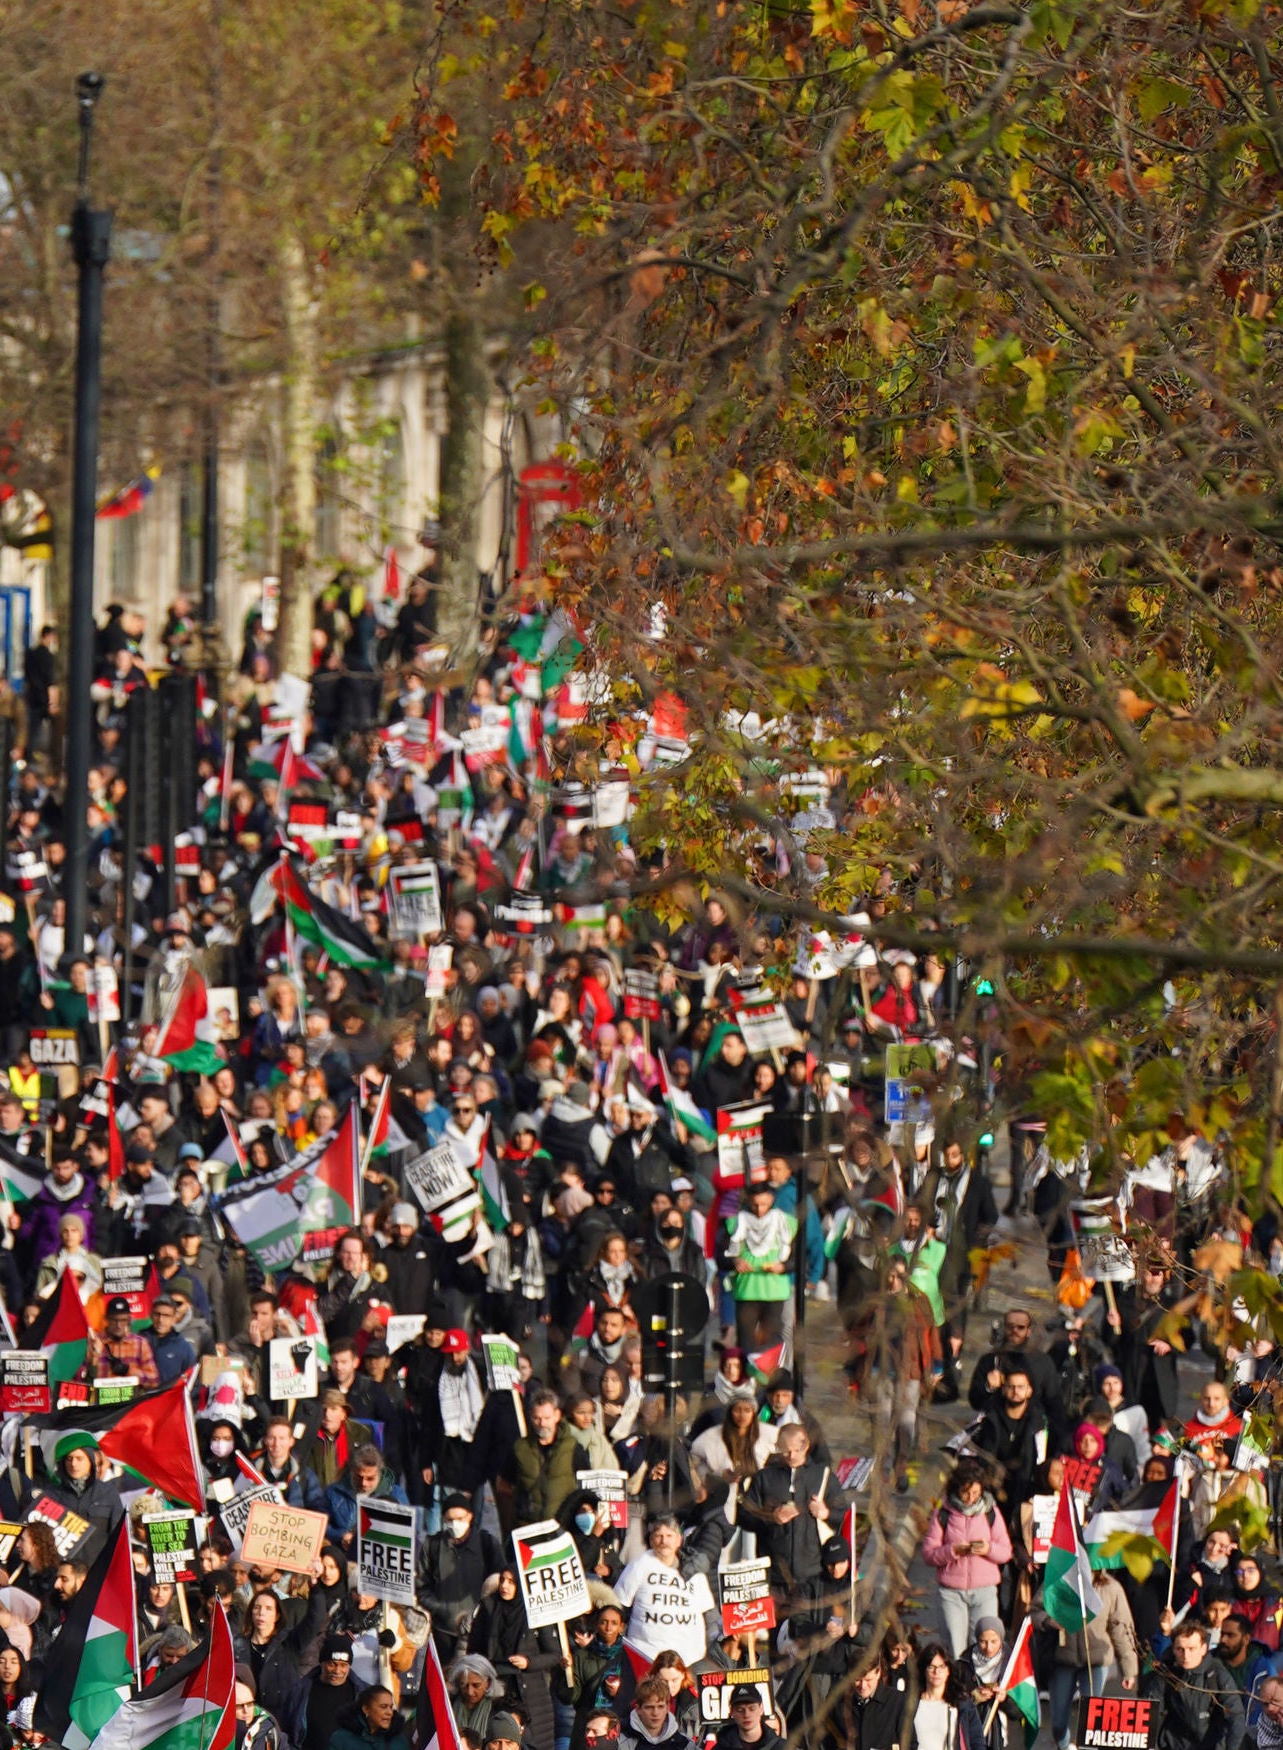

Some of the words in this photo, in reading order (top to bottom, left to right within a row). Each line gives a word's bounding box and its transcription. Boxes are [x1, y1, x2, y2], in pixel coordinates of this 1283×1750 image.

[30, 1038, 79, 1065] GAZA
[6, 1359, 45, 1371] FREEDOM
[4, 1373, 47, 1386] PALESTINE
[582, 1478, 623, 1489] FREEDOM
[153, 1549, 195, 1564] PALESTINE
[360, 1540, 411, 1574] FREE
[359, 1563, 411, 1586] PALESTINE
[524, 1555, 582, 1596] FREE
[528, 1579, 584, 1609] PALESTINE
[644, 1611, 696, 1626] NOW!
[701, 1672, 725, 1687] STOP
[726, 1668, 770, 1686] BOMBING
[1087, 1696, 1152, 1733] FREE
[1084, 1729, 1149, 1749] PALESTINE
